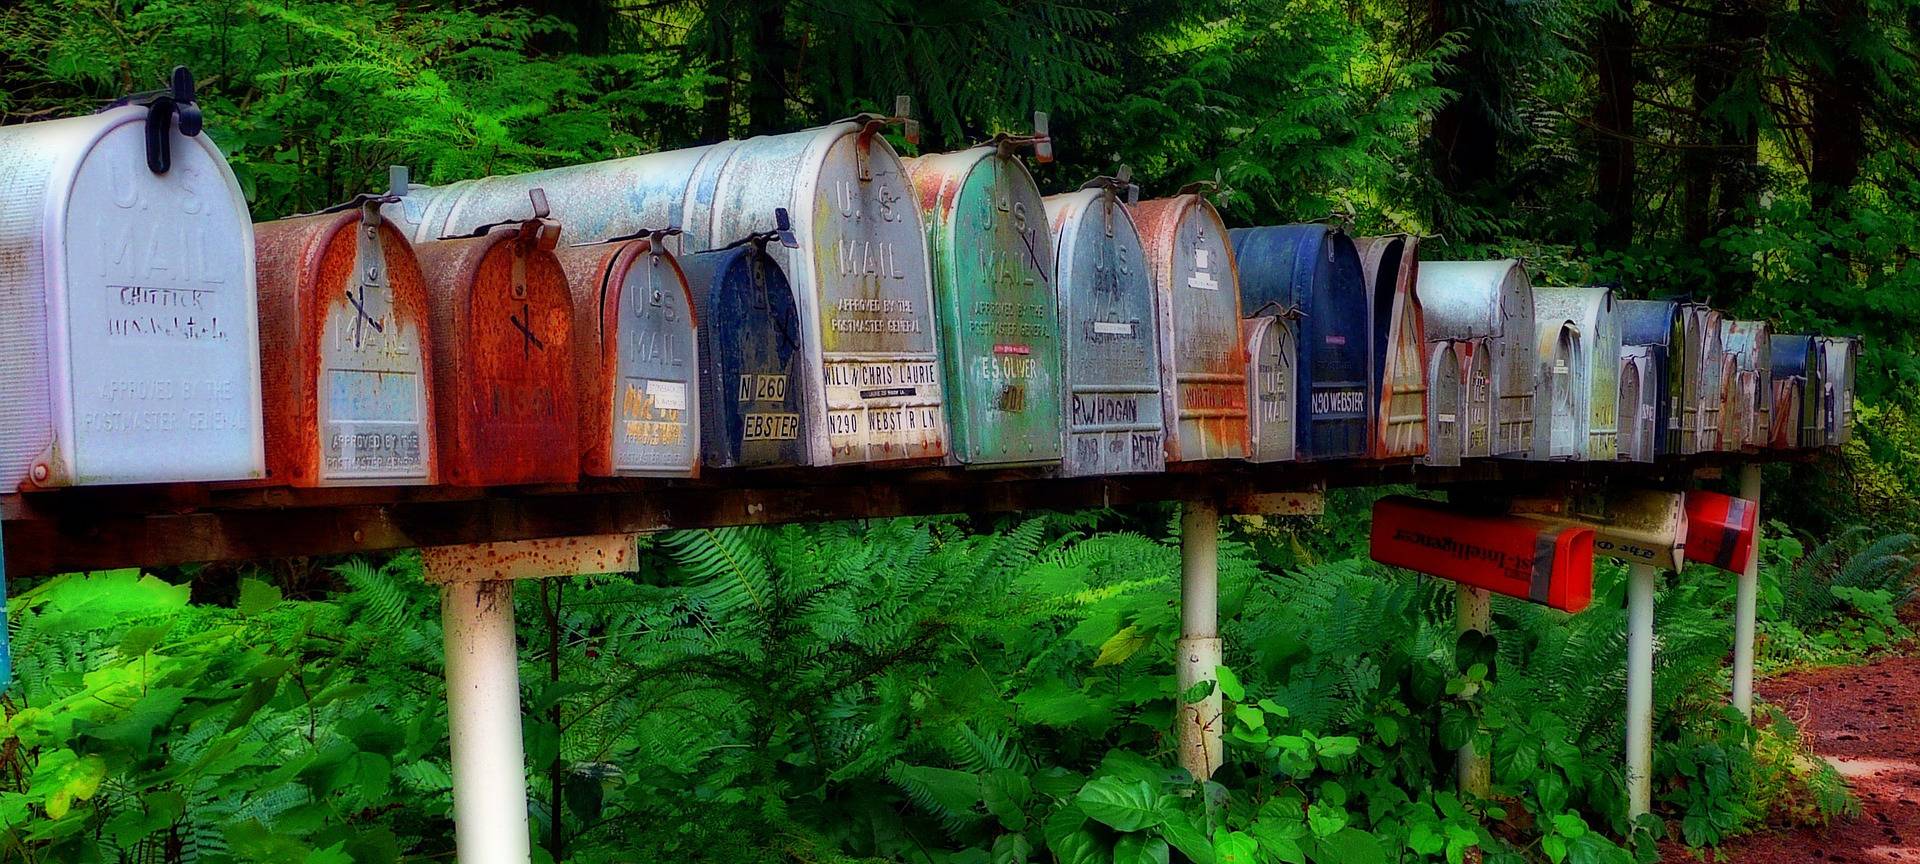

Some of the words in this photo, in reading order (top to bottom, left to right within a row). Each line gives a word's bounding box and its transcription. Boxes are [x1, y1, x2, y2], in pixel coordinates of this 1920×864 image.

[100, 216, 226, 283] MAIL
[838, 239, 905, 280] MAIL
[980, 248, 1035, 287] MAIL
[838, 298, 880, 312] APPROVED
[883, 299, 896, 313] BY
[897, 299, 914, 314] THE
[830, 318, 884, 333] POSTMASTER
[887, 320, 922, 335] GENERAL
[631, 329, 682, 367] MAIL
[824, 365, 849, 386] WILL
[862, 365, 892, 385] CHRIS
[899, 364, 935, 384] LAURIE
[1003, 356, 1037, 379] OLIVER
[741, 377, 751, 399] N
[757, 377, 785, 398] 260
[1330, 392, 1364, 413] WEBSTER
[745, 416, 798, 438] EBSTER
[829, 414, 858, 434] N290
[922, 410, 936, 428] LN
[332, 434, 381, 450] APPROVED
[383, 435, 397, 449] BY
[399, 435, 419, 450] THE
